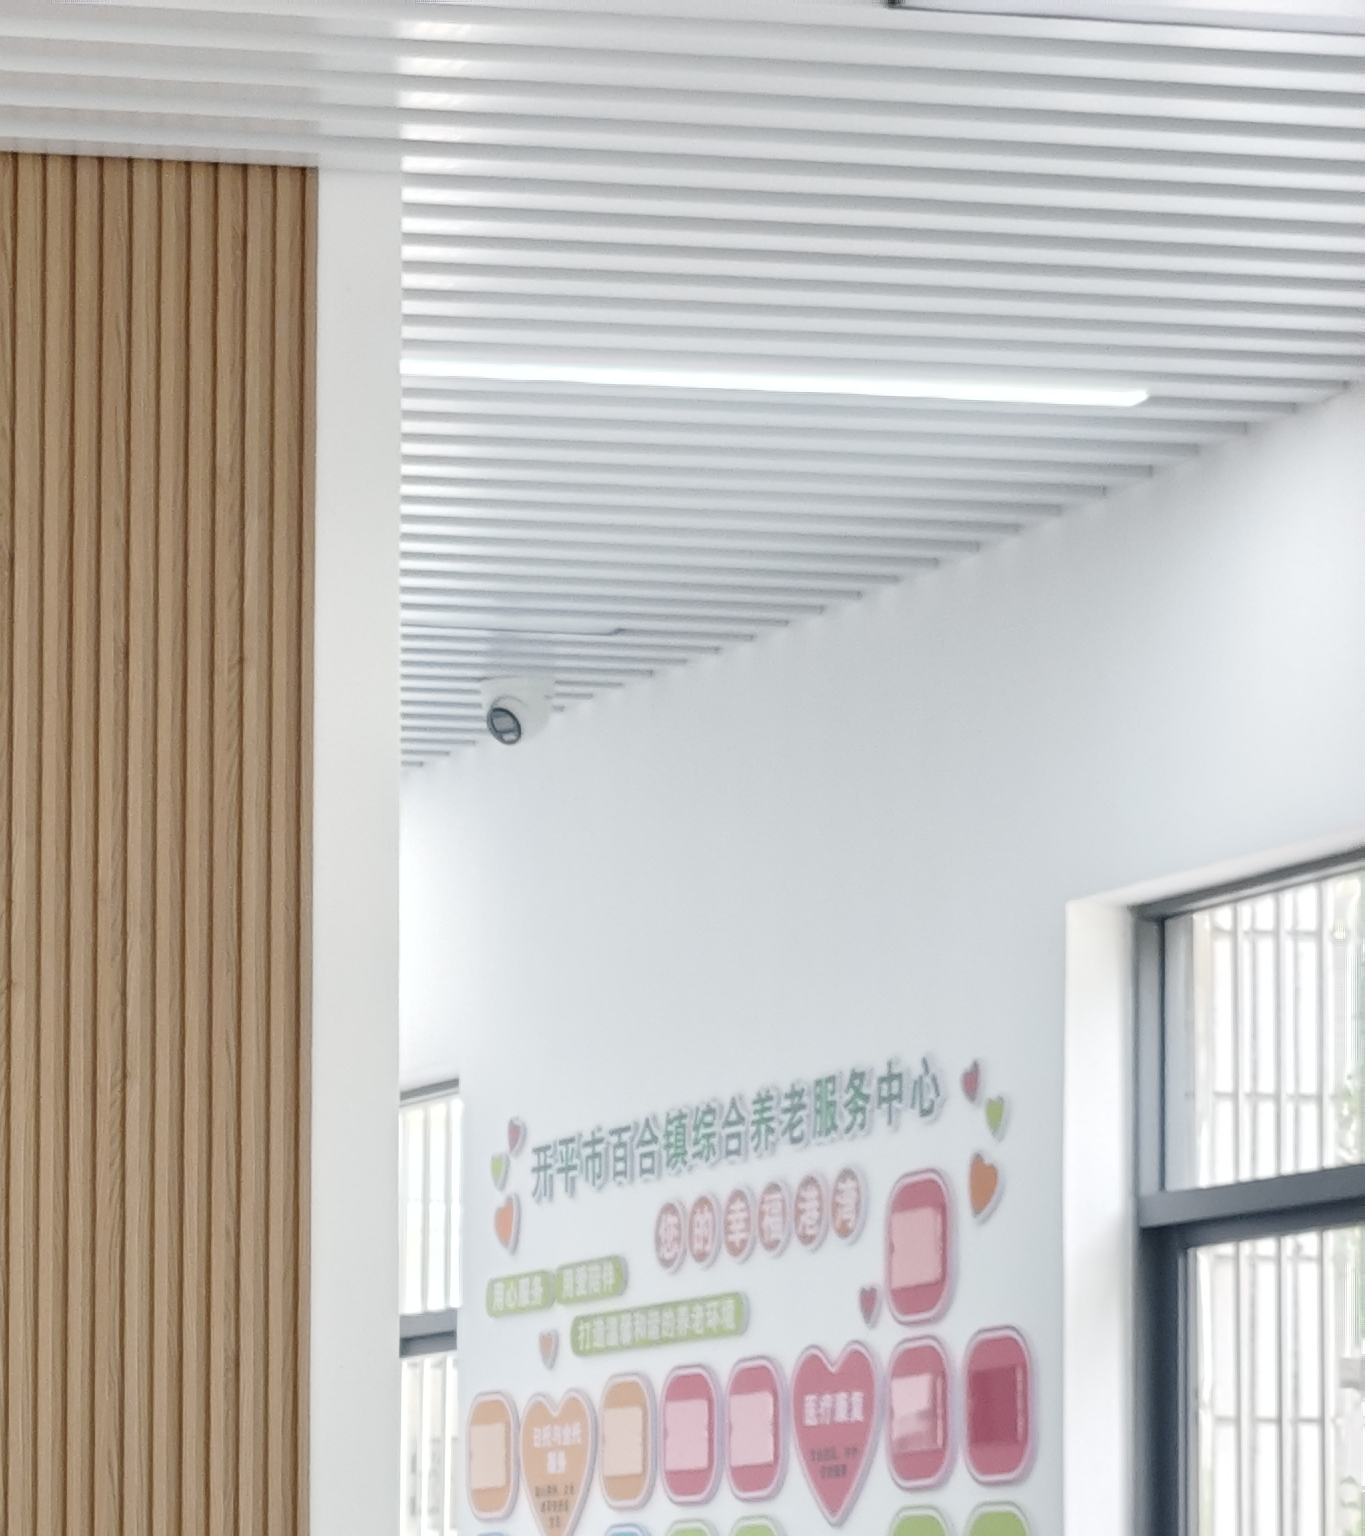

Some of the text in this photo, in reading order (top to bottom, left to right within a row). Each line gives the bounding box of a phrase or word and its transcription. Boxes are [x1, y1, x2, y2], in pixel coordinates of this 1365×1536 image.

[531, 1057, 942, 1200] 开平市百合镇综合养老服务中心
